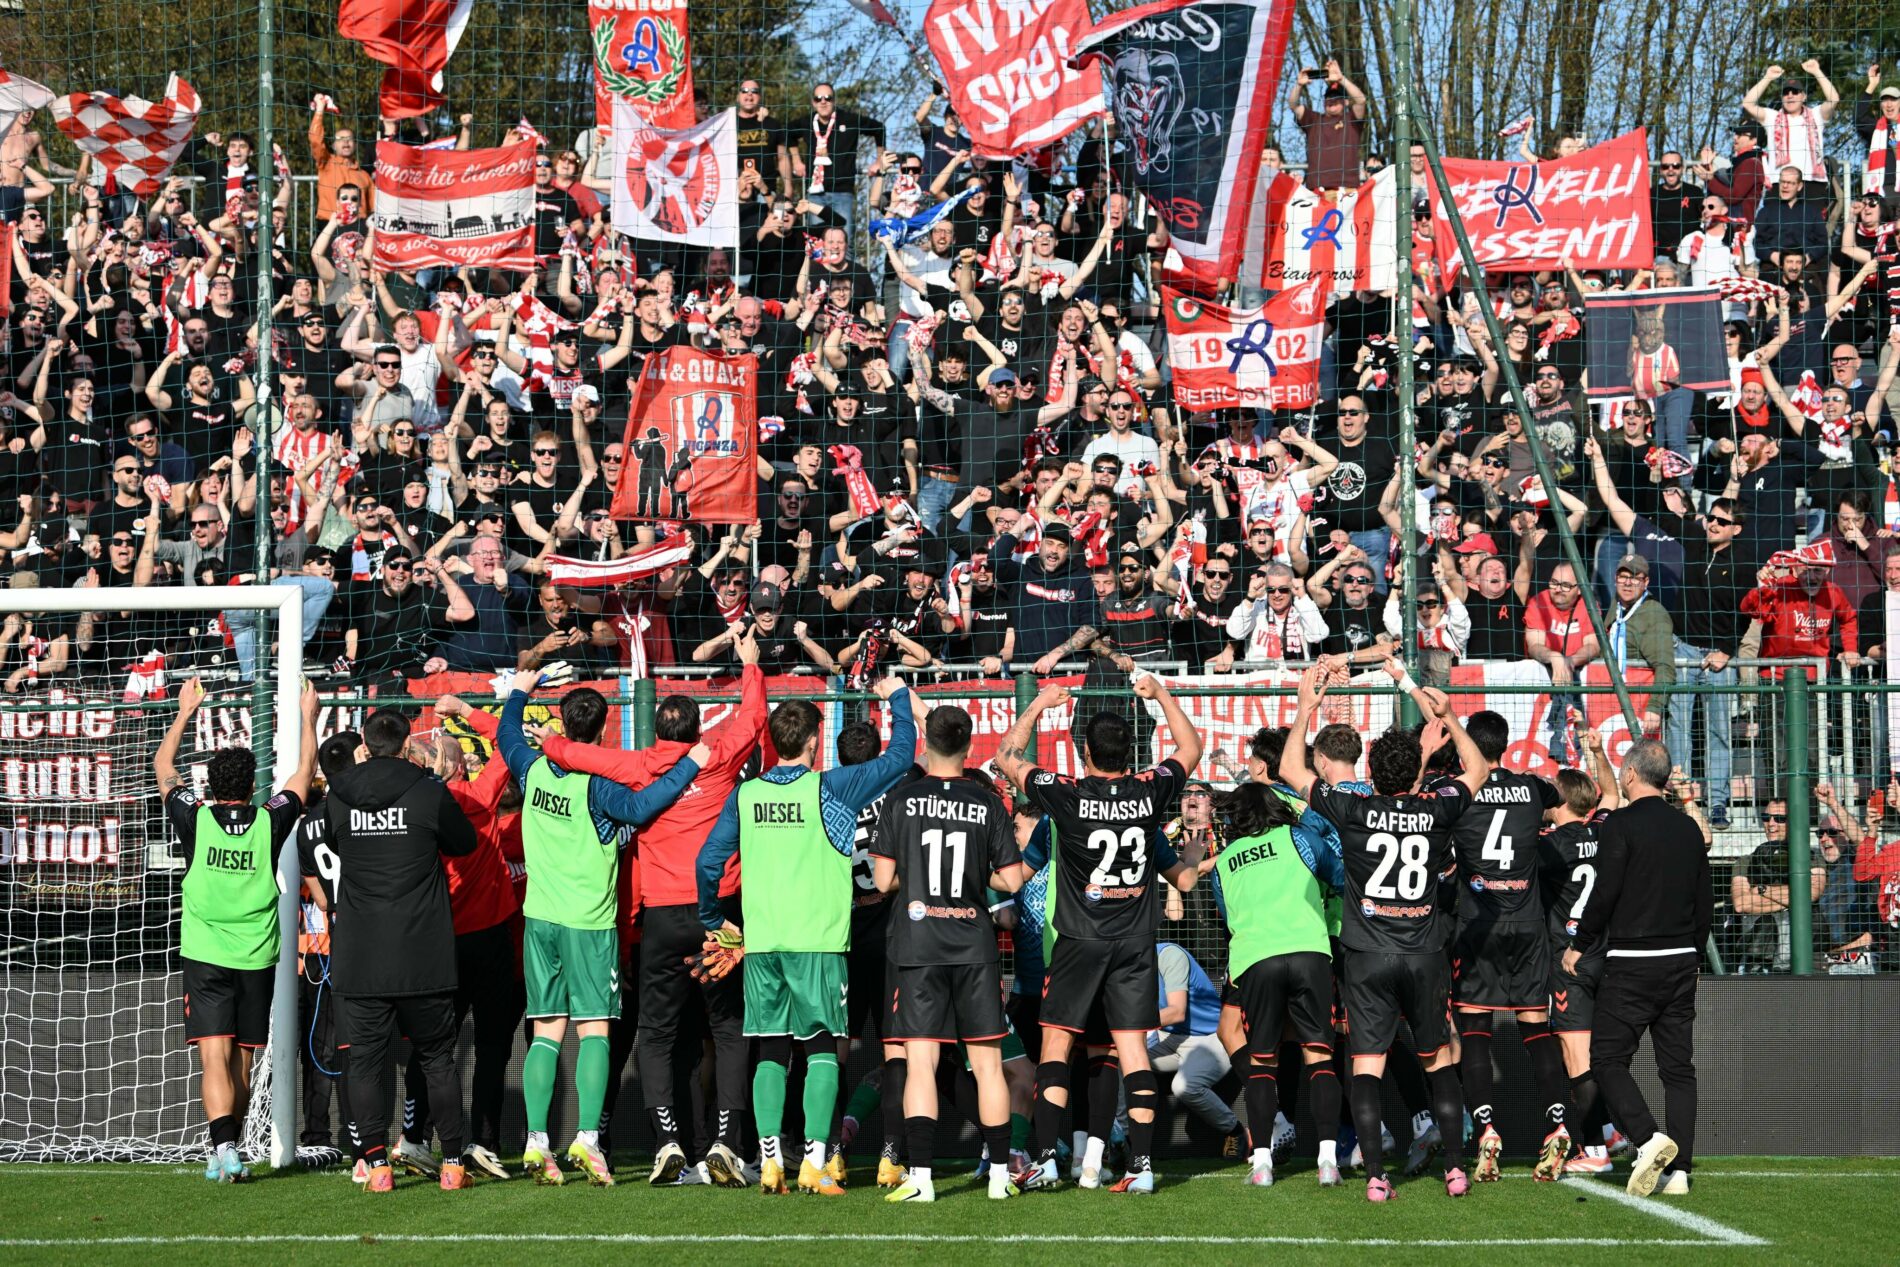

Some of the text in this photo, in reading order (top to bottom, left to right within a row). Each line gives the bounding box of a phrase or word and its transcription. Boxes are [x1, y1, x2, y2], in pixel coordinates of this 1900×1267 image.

[1447, 210, 1640, 272] ASSENTI
[1190, 338, 1223, 364] 19
[1275, 334, 1307, 360] 02
[669, 361, 685, 383] &
[687, 358, 747, 387] QUALI
[683, 438, 739, 452] VICENZA
[531, 787, 572, 817] DIESEL
[1079, 796, 1153, 821] BENASSAI
[1474, 785, 1531, 803] ARRARO
[350, 808, 407, 831] DIESEL
[753, 803, 805, 823] DIESEL
[905, 794, 987, 825] STÜCKLER
[1366, 810, 1434, 832] CAFERRI
[1481, 809, 1515, 870] 4
[206, 846, 256, 870] DIESEL
[921, 829, 967, 898] 11
[1087, 826, 1147, 886] 23
[1228, 842, 1277, 872] DIESEL
[1365, 832, 1430, 900] 28
[313, 842, 341, 904] 9
[1570, 863, 1596, 919] 2
